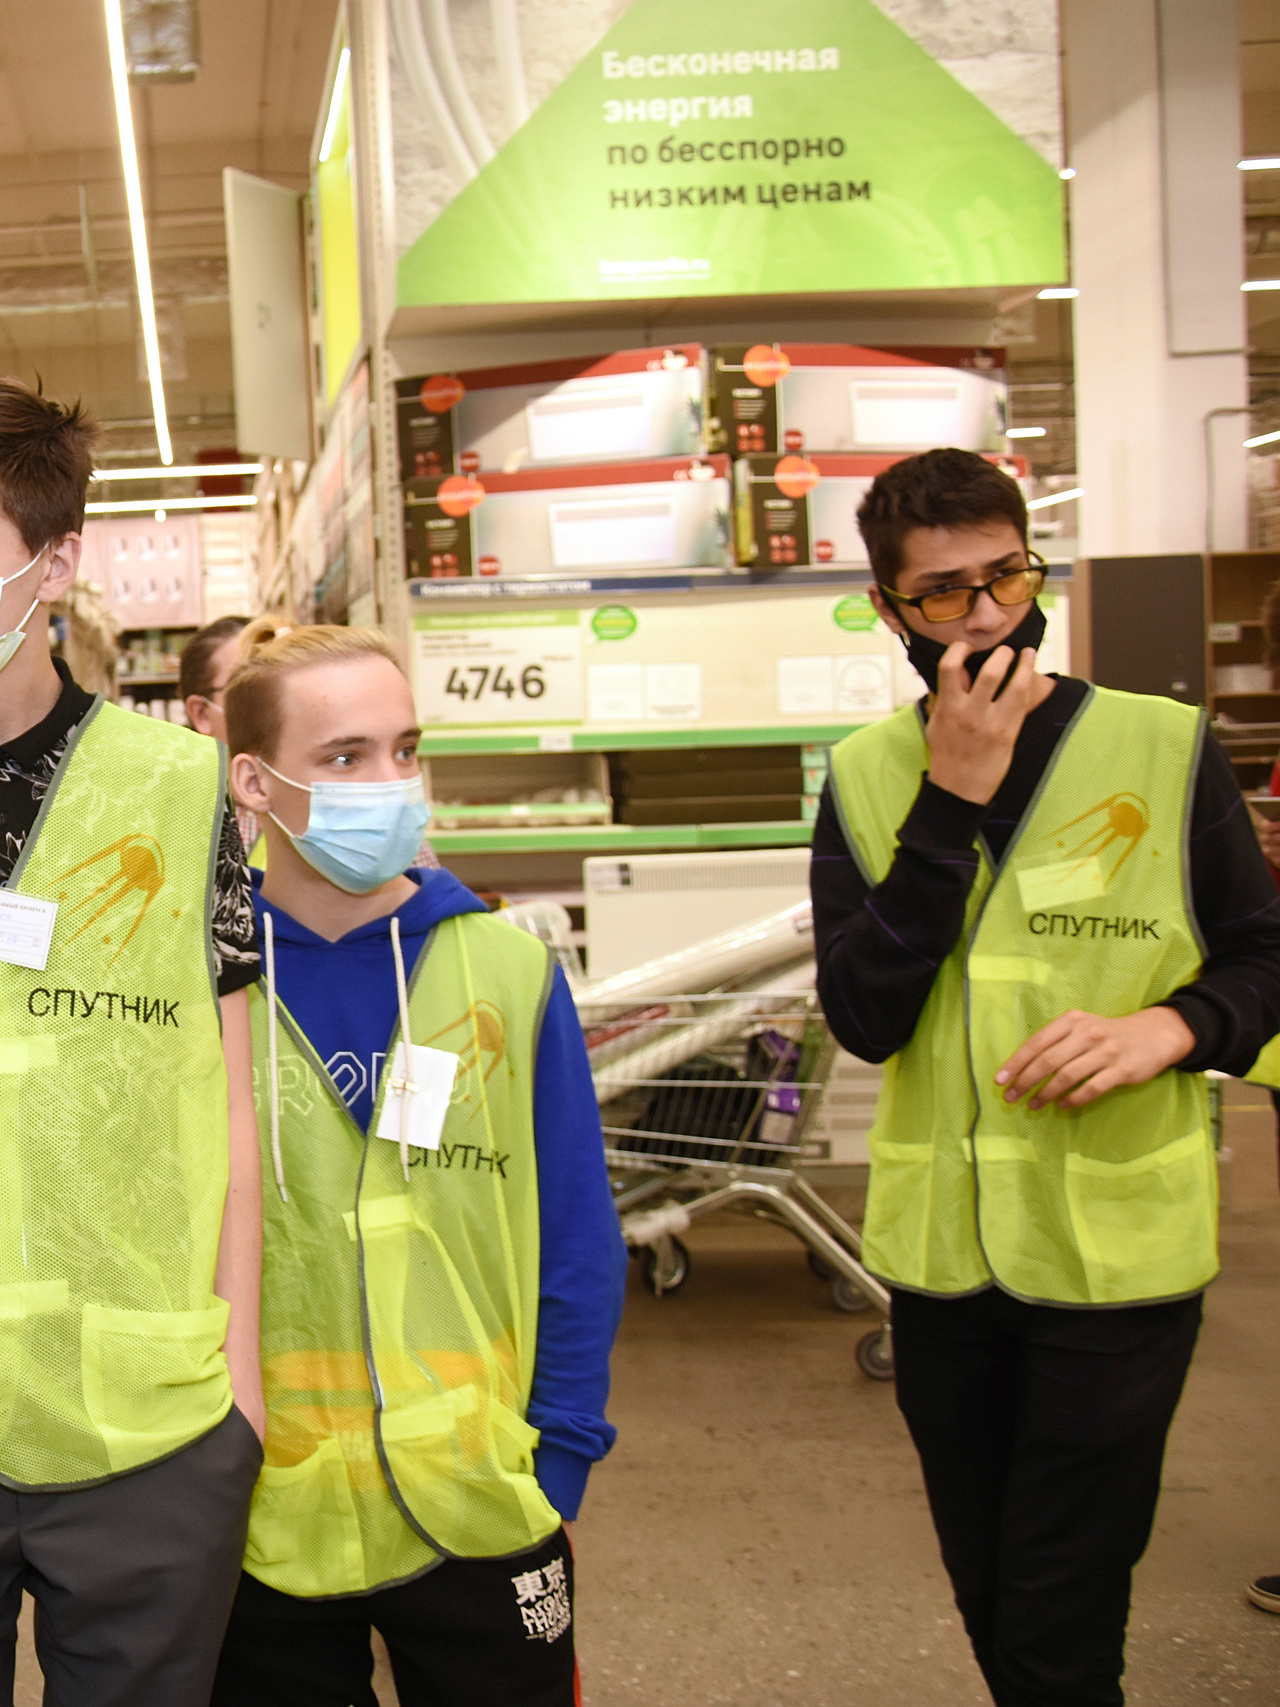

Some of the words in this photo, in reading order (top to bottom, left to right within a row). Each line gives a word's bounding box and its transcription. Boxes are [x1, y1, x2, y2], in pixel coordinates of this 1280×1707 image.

[601, 47, 840, 79] Бесконечная
[602, 94, 754, 128] энергия
[606, 143, 648, 165] по
[657, 134, 846, 167] бесспорно
[609, 184, 747, 209] низким
[756, 180, 872, 211] ценам
[445, 664, 547, 702] 4746
[1028, 912, 1161, 940] СПУТНИК
[27, 987, 179, 1028] СПУТНИК
